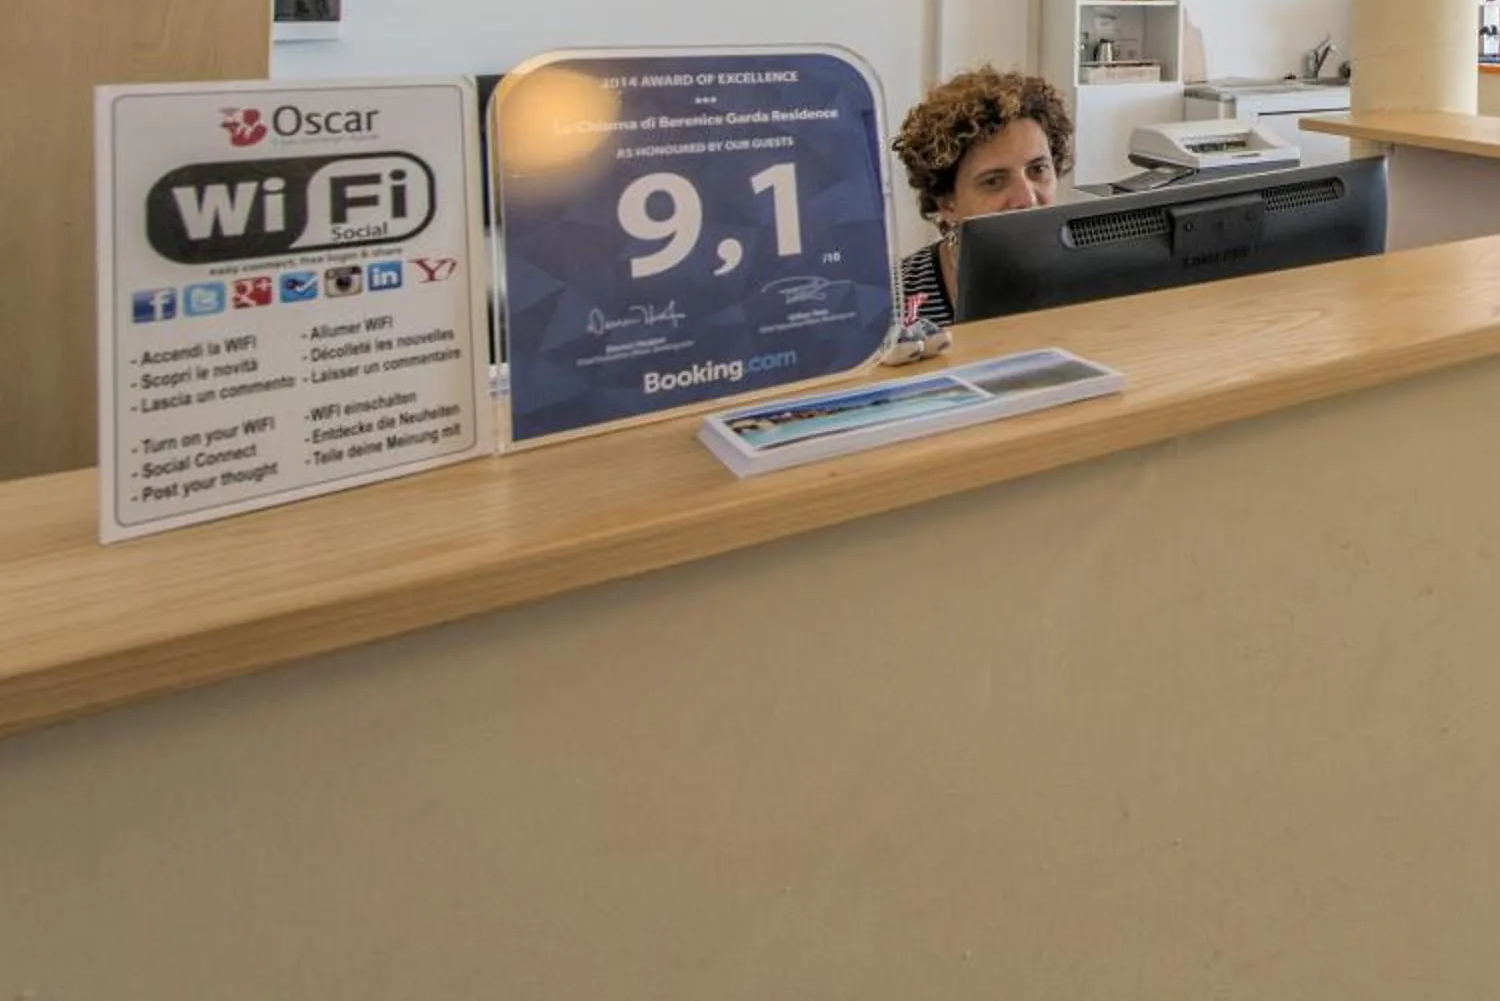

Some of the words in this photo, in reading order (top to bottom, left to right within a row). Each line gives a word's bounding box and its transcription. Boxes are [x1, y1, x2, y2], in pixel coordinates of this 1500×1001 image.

[640, 73, 694, 88] AWARD
[695, 72, 714, 86] OF
[717, 70, 799, 85] EXCELLENCE
[272, 104, 381, 137] Oscar
[640, 115, 656, 130] di
[658, 112, 723, 129] Berenice
[725, 109, 770, 125] Garda
[771, 107, 840, 122] Residence
[616, 147, 634, 159] AS
[635, 141, 707, 157] HONOURED
[708, 141, 724, 152] BY
[724, 138, 750, 152] OUR
[751, 135, 795, 150] GUESTS
[331, 221, 389, 242] Social
[617, 162, 802, 278] 9,1
[141, 344, 203, 366] Accendi
[207, 342, 221, 356] la
[375, 337, 394, 352] les
[397, 328, 455, 347] nouvelles
[141, 367, 192, 389] Scopri
[196, 365, 210, 380] le
[311, 364, 360, 384] Laisser
[363, 361, 380, 375] un
[383, 348, 462, 372] commentaire
[643, 350, 797, 394] Booking.com
[141, 392, 192, 414] Lascia
[197, 390, 216, 404] un
[219, 375, 296, 400] commento
[141, 437, 178, 455] Turn
[181, 432, 202, 448] on
[205, 425, 239, 447] your
[312, 422, 374, 445] Entdecke
[377, 415, 396, 431] die
[399, 403, 461, 425] Neuheiten
[347, 441, 383, 459] deine
[386, 429, 439, 450] Meinung
[441, 421, 462, 439] mit
[141, 455, 191, 479] Social
[194, 443, 257, 468] Connect
[141, 482, 178, 503] Post
[181, 475, 217, 499] your
[220, 461, 278, 486] thought
